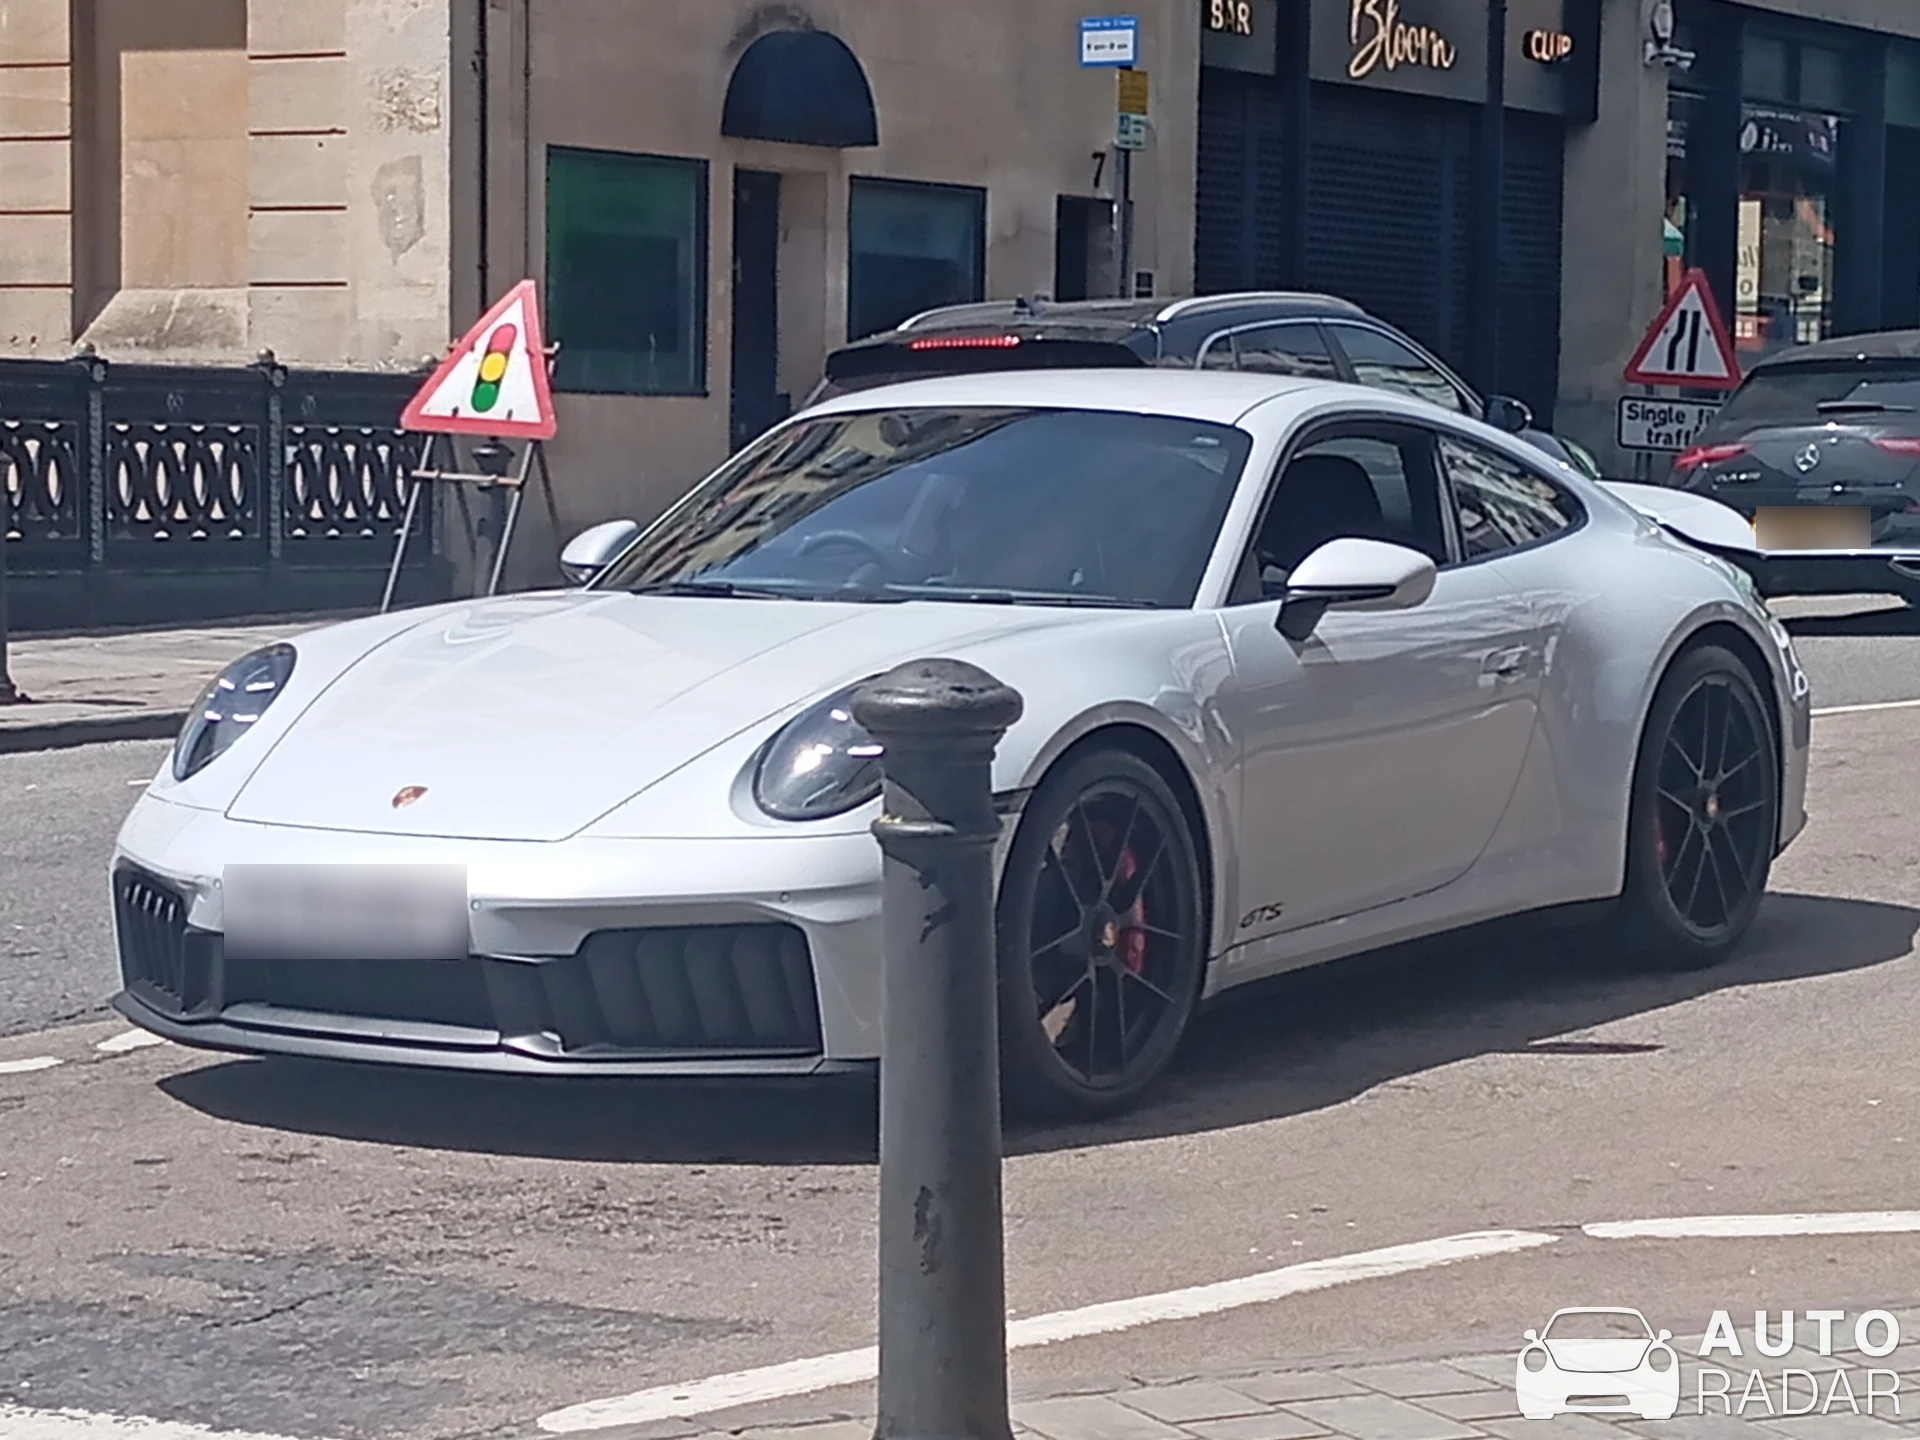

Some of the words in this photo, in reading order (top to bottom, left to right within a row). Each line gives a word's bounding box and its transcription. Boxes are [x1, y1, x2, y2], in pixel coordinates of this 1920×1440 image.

[1211, 0, 1250, 34] BAR
[1350, 0, 1456, 77] Bloom
[1091, 151, 1106, 188] 7
[1627, 403, 1686, 428] Single
[1240, 902, 1282, 928] GTS
